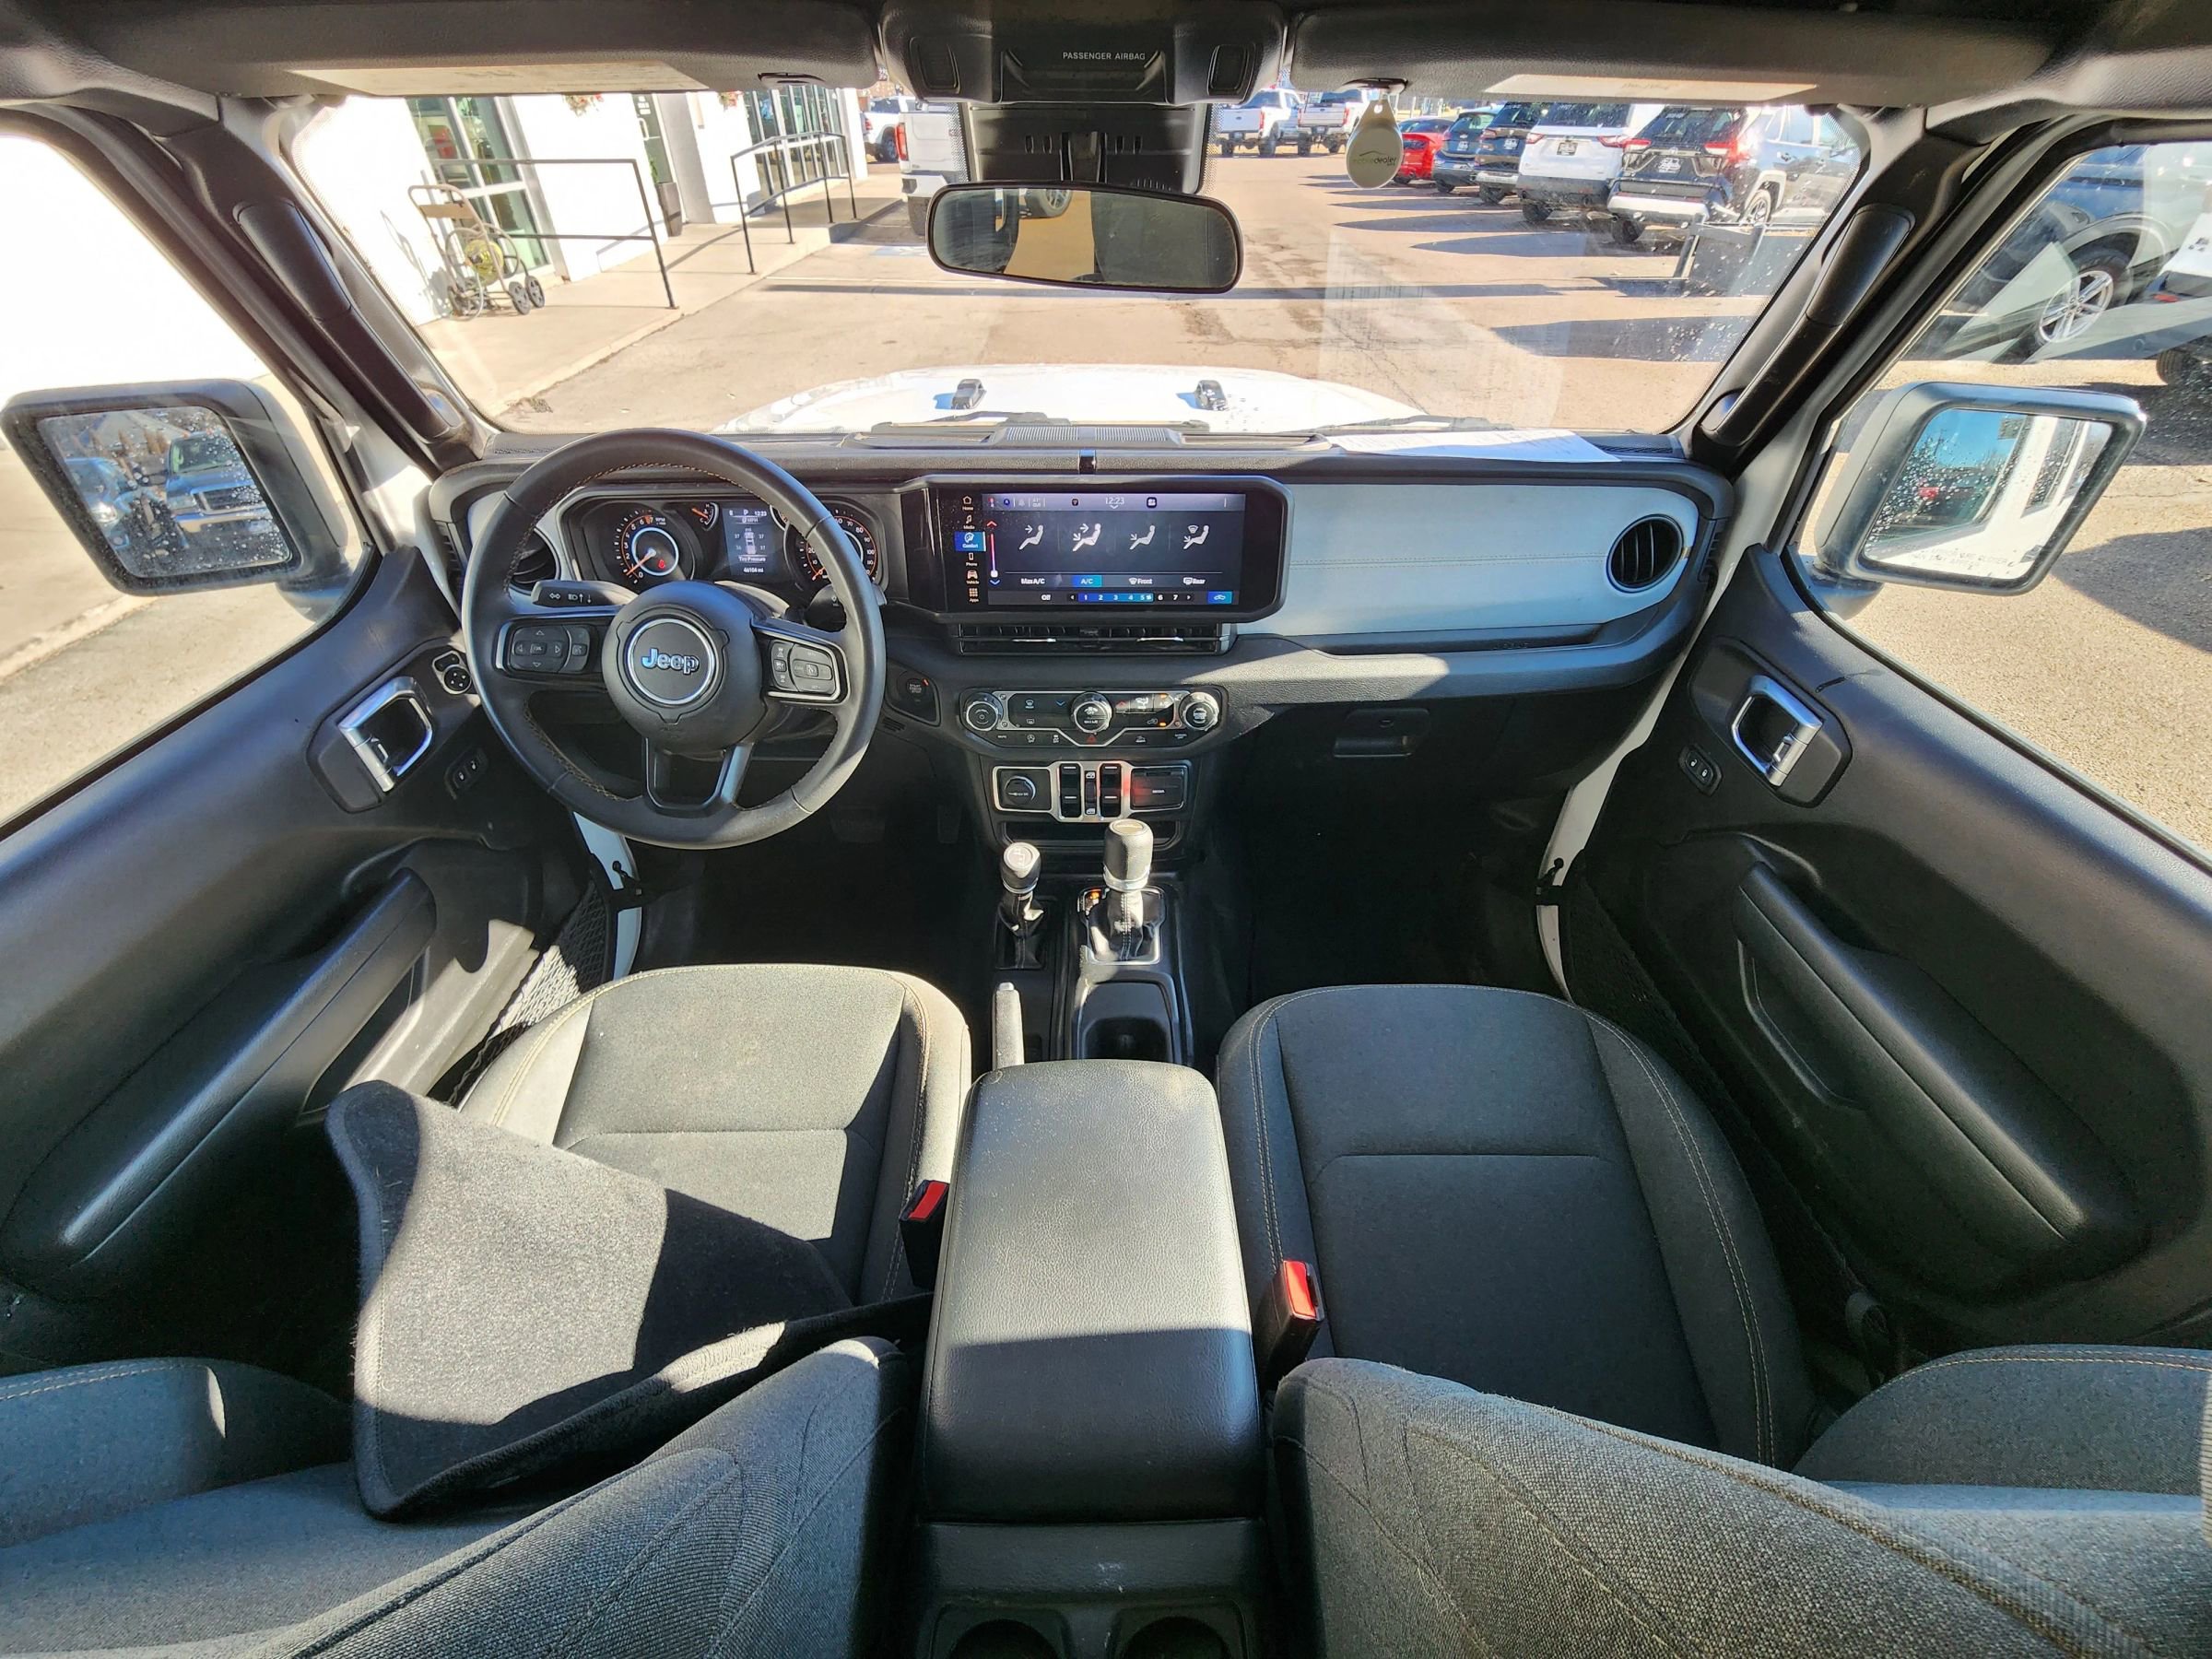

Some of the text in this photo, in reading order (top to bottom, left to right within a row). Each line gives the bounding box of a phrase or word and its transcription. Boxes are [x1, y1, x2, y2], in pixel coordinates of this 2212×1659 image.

[1062, 52, 1146, 61] PASSENGER AIRBAG
[641, 648, 700, 676] Jeep
